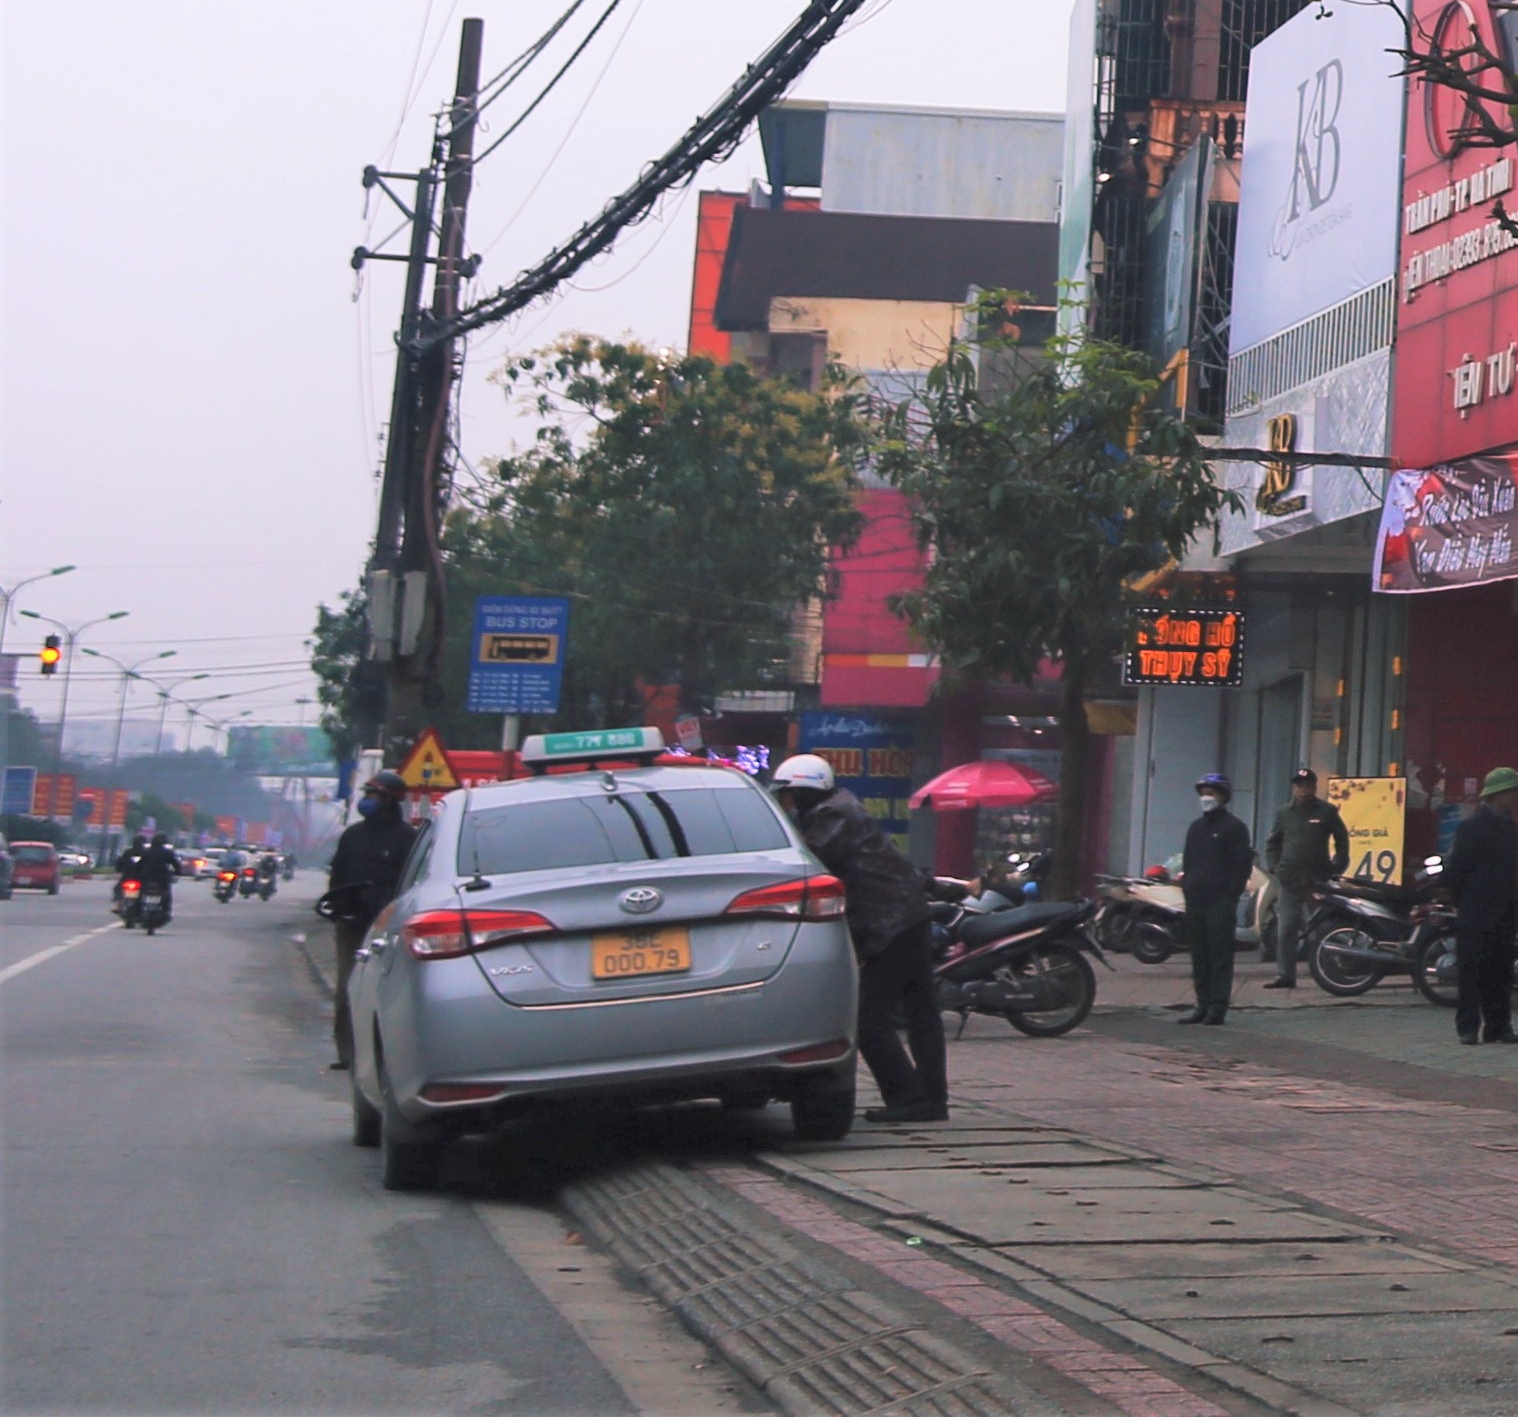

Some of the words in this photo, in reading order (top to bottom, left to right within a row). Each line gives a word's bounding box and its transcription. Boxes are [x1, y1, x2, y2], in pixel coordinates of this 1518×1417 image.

[486, 616, 516, 628] BUS
[519, 616, 558, 629] STOP
[603, 948, 679, 974] 000.79
